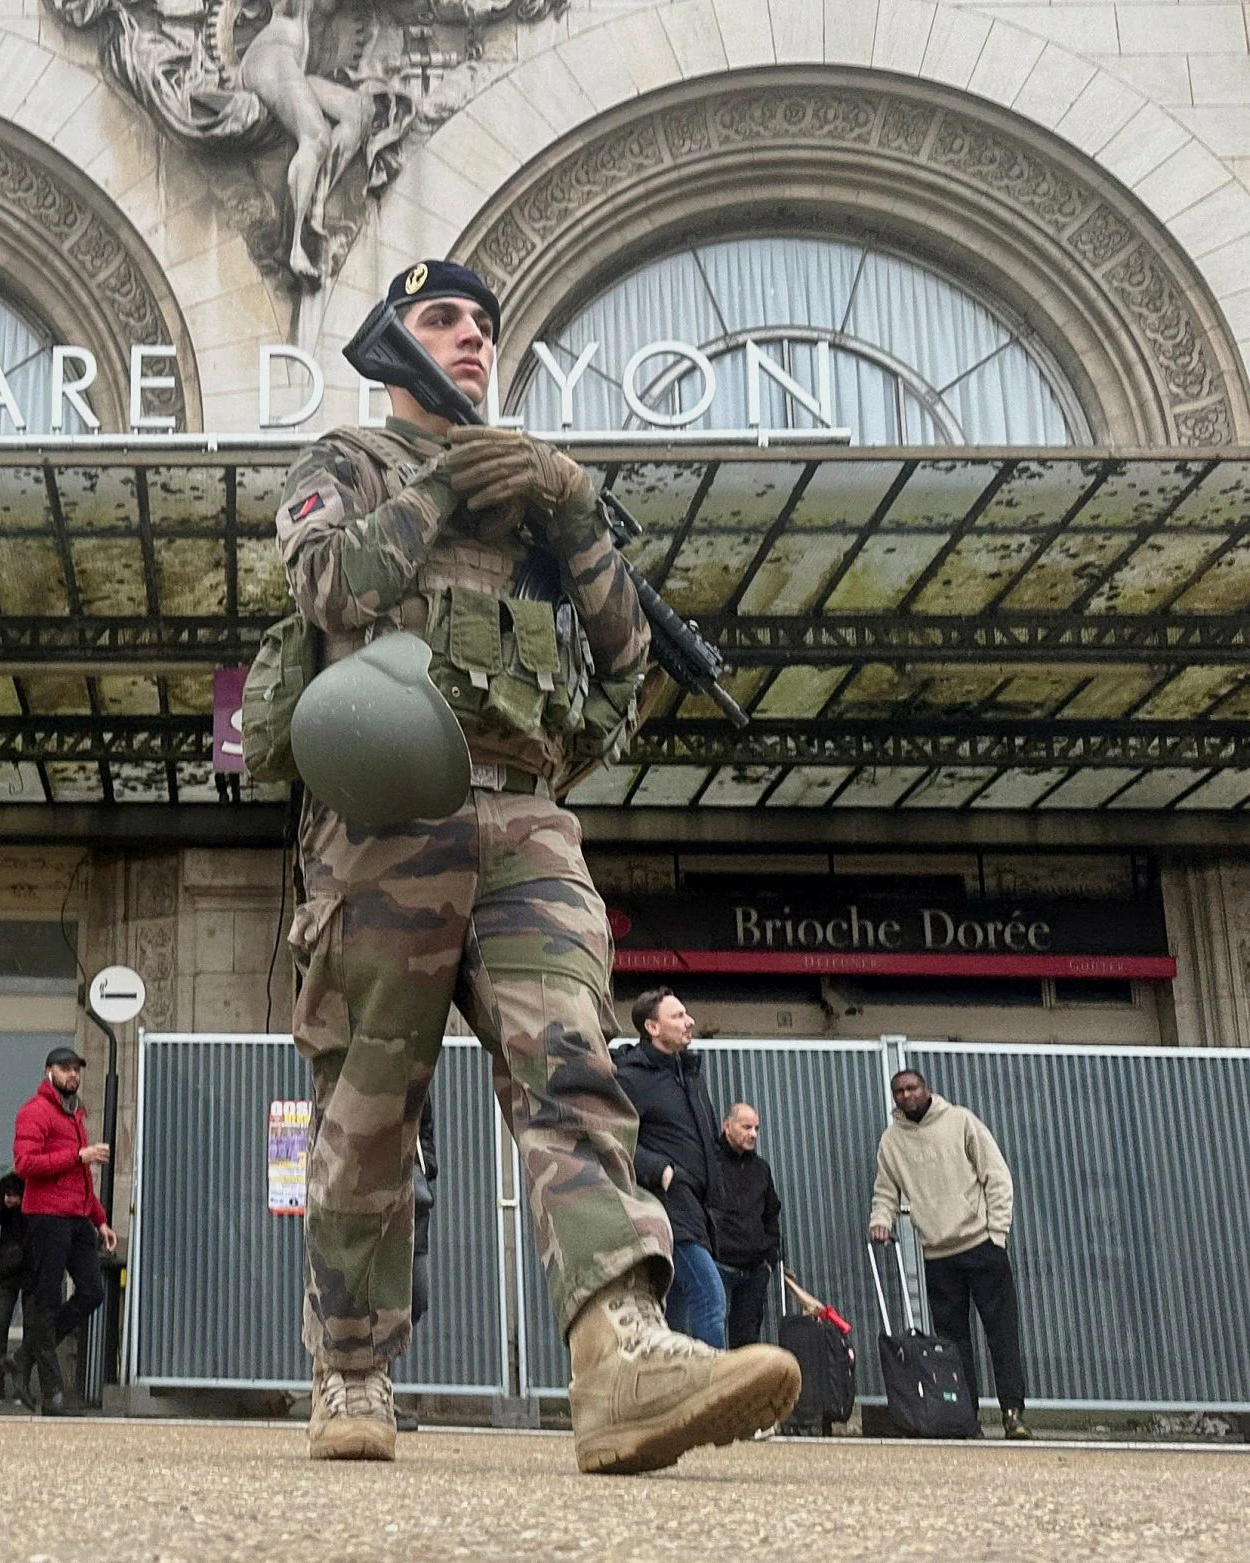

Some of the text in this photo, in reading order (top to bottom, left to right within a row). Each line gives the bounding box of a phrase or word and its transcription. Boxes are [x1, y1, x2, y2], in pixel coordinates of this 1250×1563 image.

[488, 340, 832, 428] LYON
[735, 905, 1051, 950] Brioche Dorée
